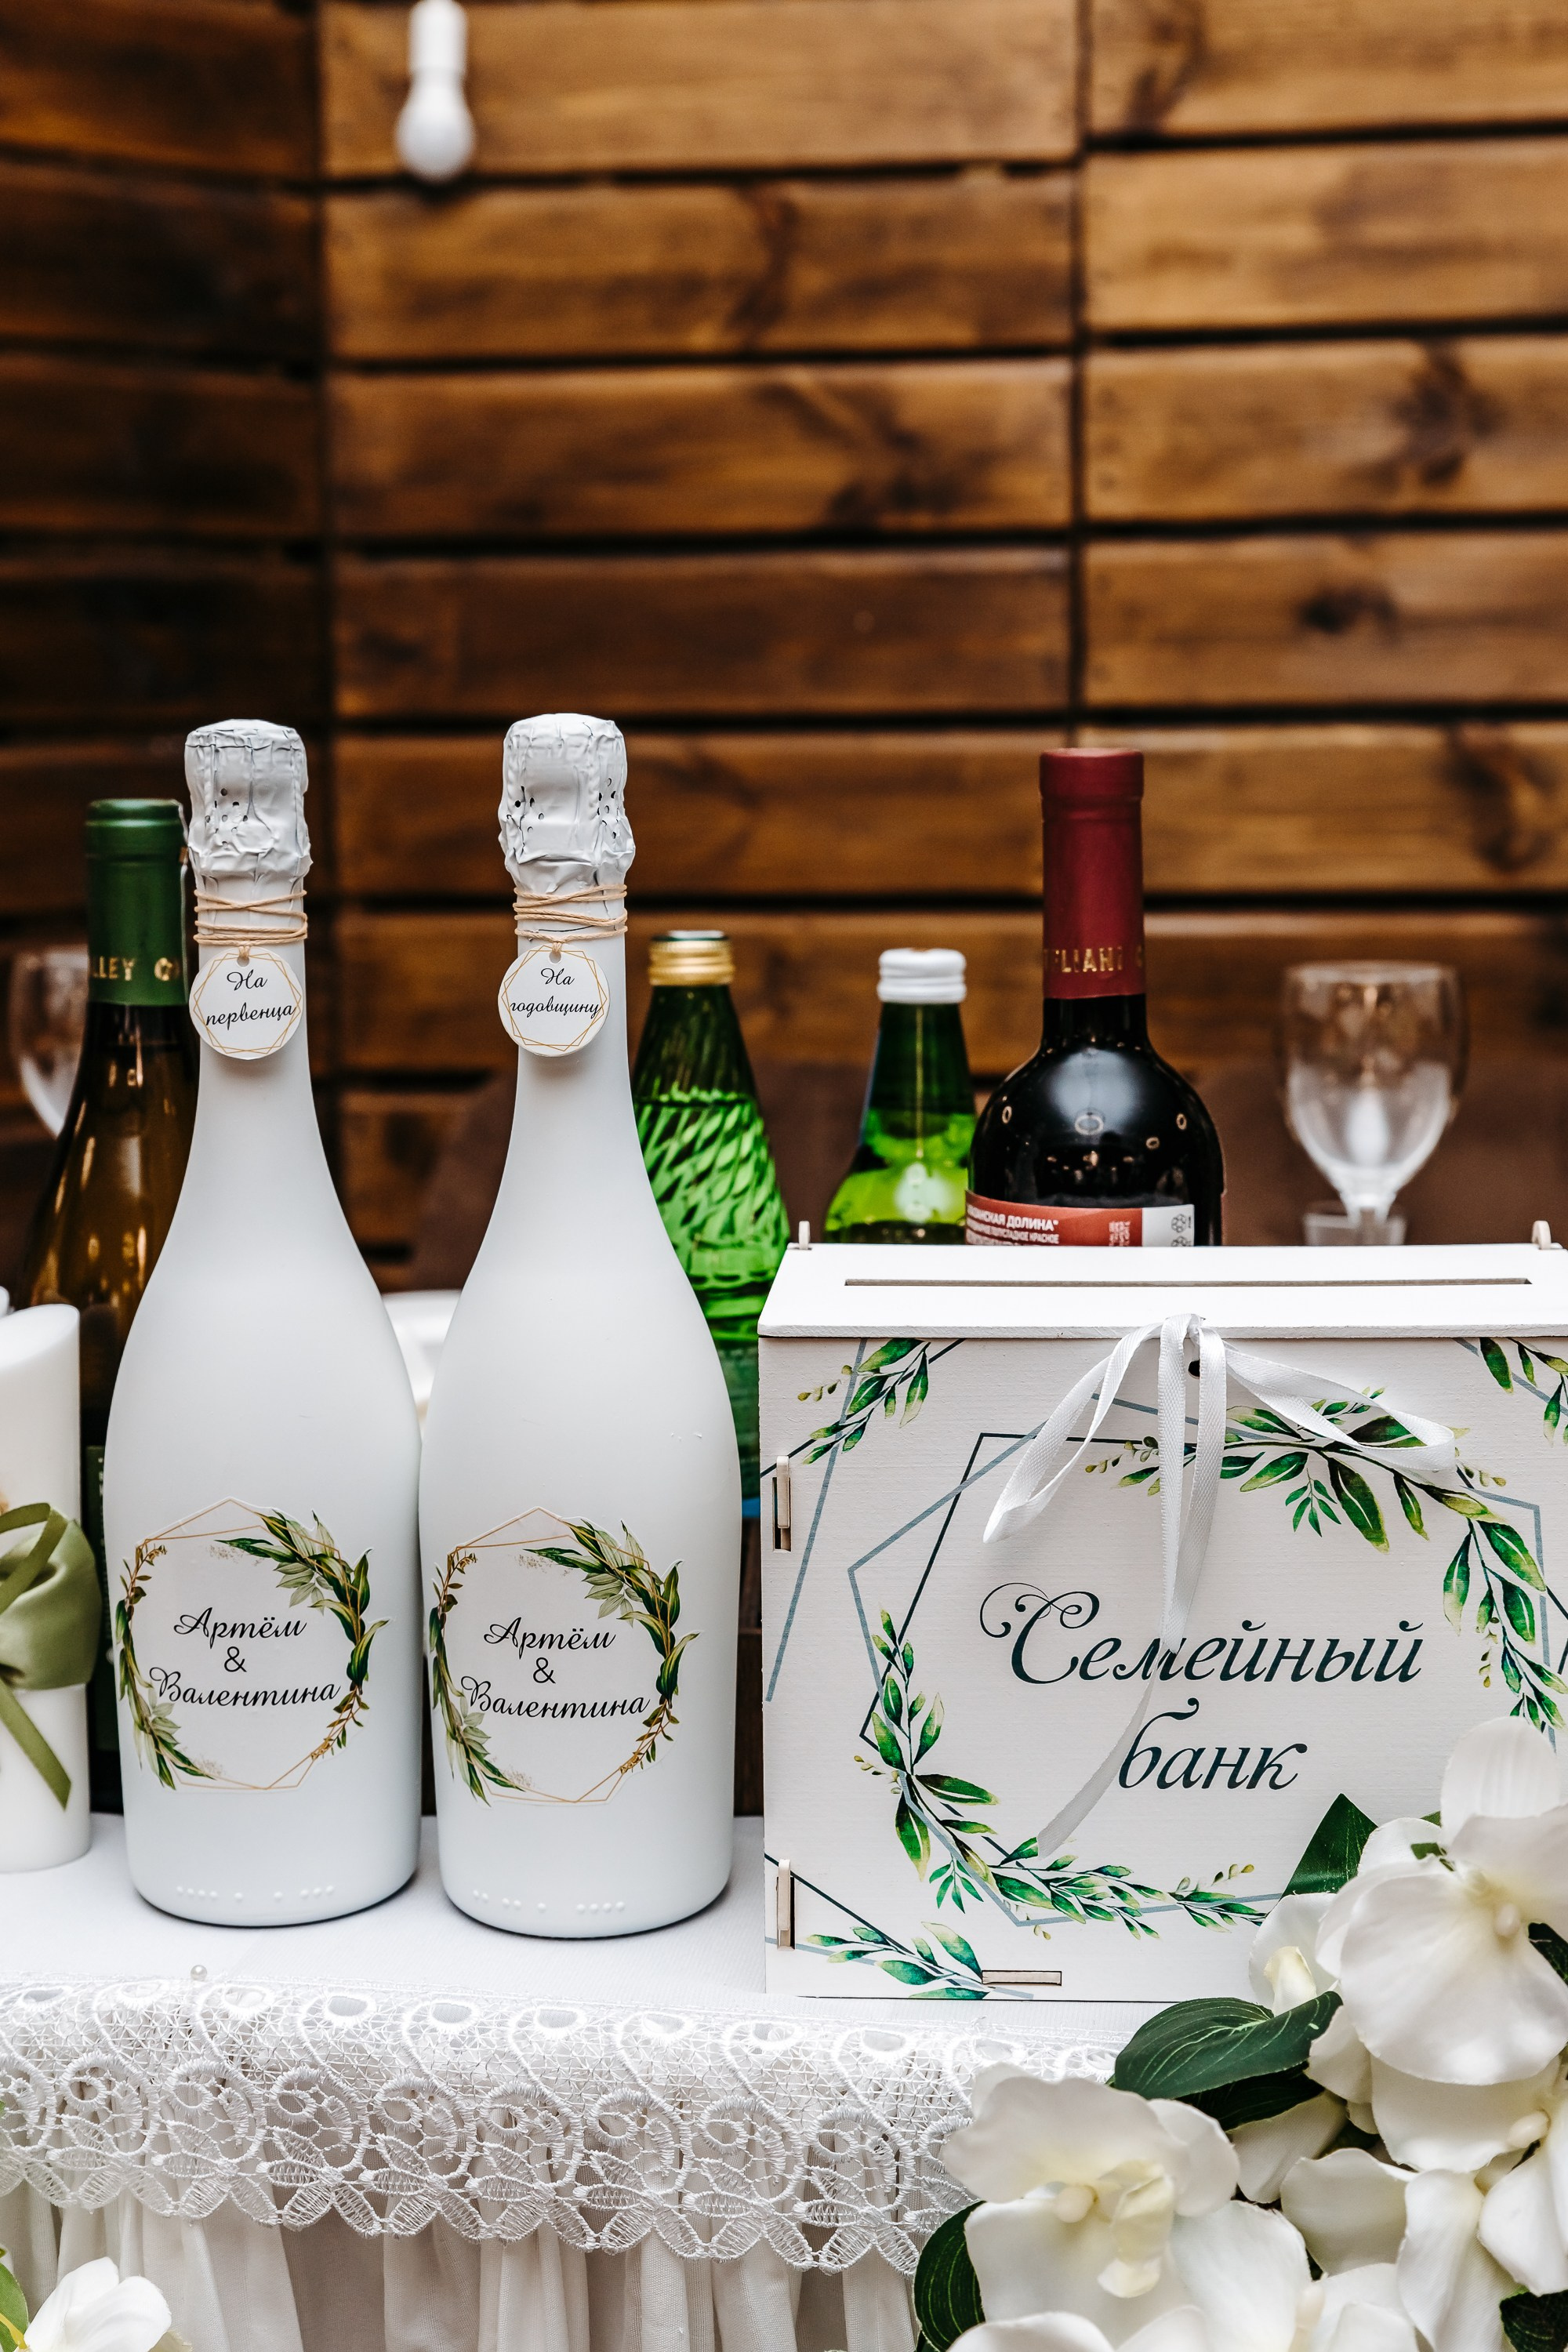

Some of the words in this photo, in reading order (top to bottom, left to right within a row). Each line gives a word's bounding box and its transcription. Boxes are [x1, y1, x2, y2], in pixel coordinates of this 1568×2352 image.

[227, 969, 268, 991] На
[540, 967, 575, 985] На
[205, 1002, 296, 1031] первенца
[510, 995, 602, 1019] годовщину
[173, 1606, 307, 1650] Артём
[483, 1617, 616, 1660] Артём
[979, 1582, 1424, 1685] Семейный
[223, 1646, 247, 1673] &
[532, 1657, 557, 1684] &
[149, 1666, 341, 1708] Валентина
[460, 1675, 651, 1719] Валентина
[1118, 1697, 1308, 1791] банк
